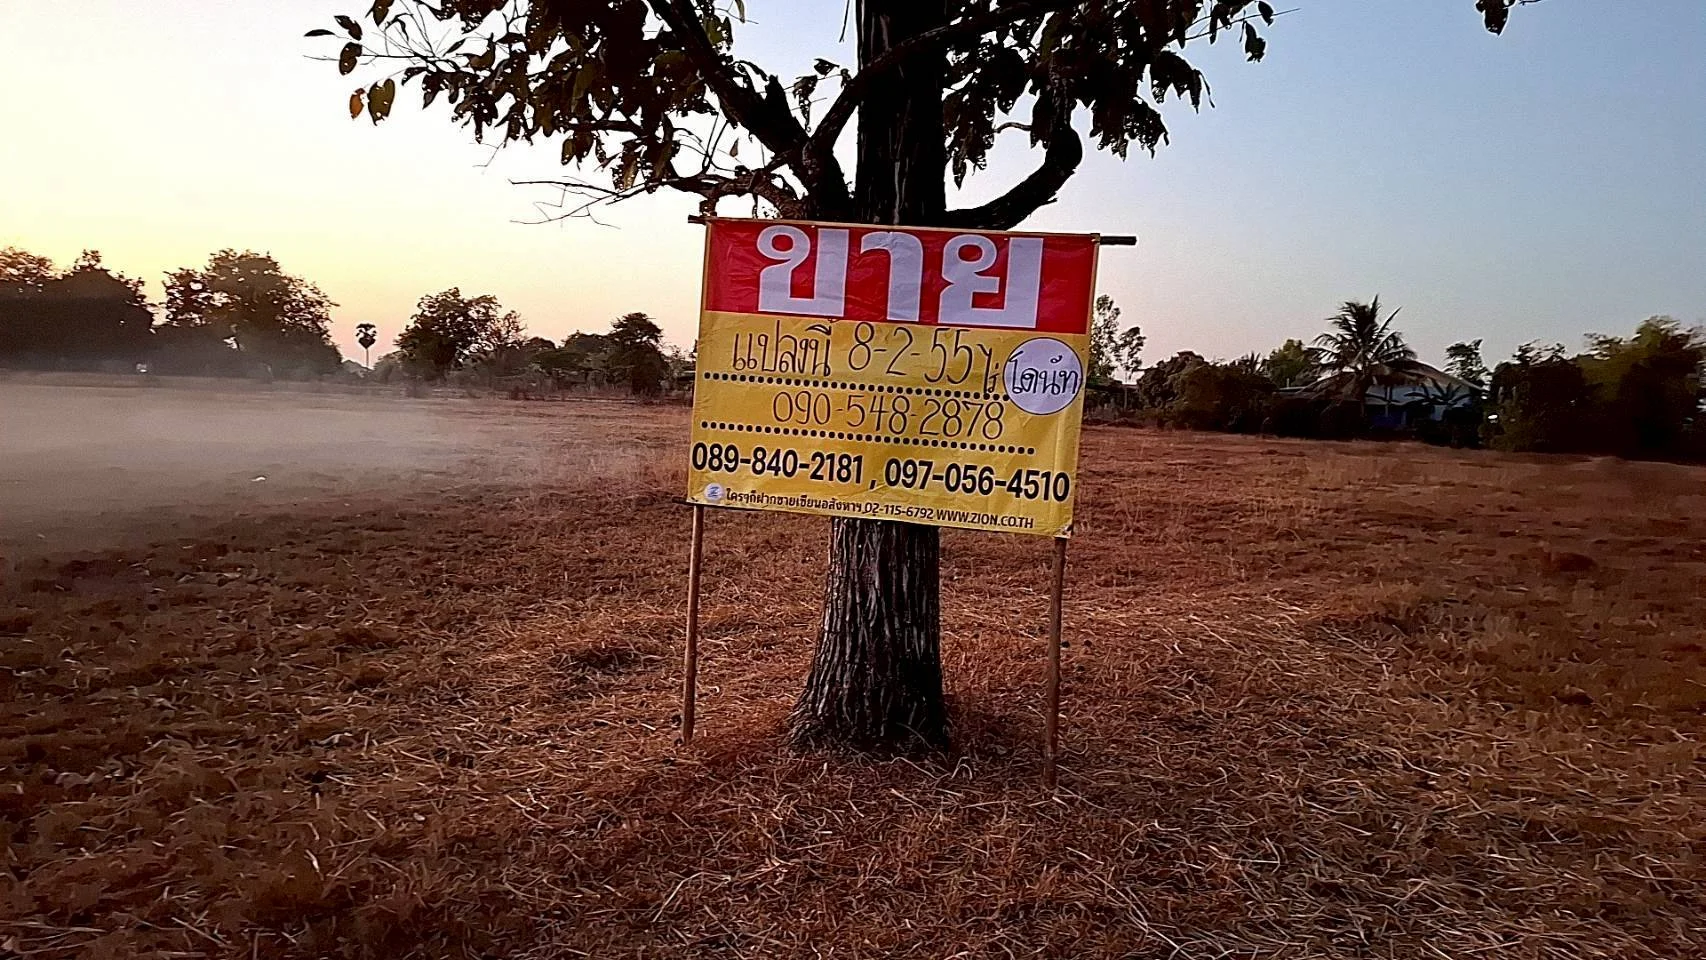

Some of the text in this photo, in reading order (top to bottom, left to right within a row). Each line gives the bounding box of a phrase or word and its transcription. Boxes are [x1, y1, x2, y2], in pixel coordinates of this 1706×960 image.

[756, 225, 1045, 329] ขาย
[848, 321, 973, 385] 8-2-55
[1007, 350, 1079, 396] โดนัท
[773, 390, 1005, 440] 090-548-2878
[884, 457, 1070, 503] 097-056-4510
[936, 509, 1034, 529] WWW.ZION.CO.TH
